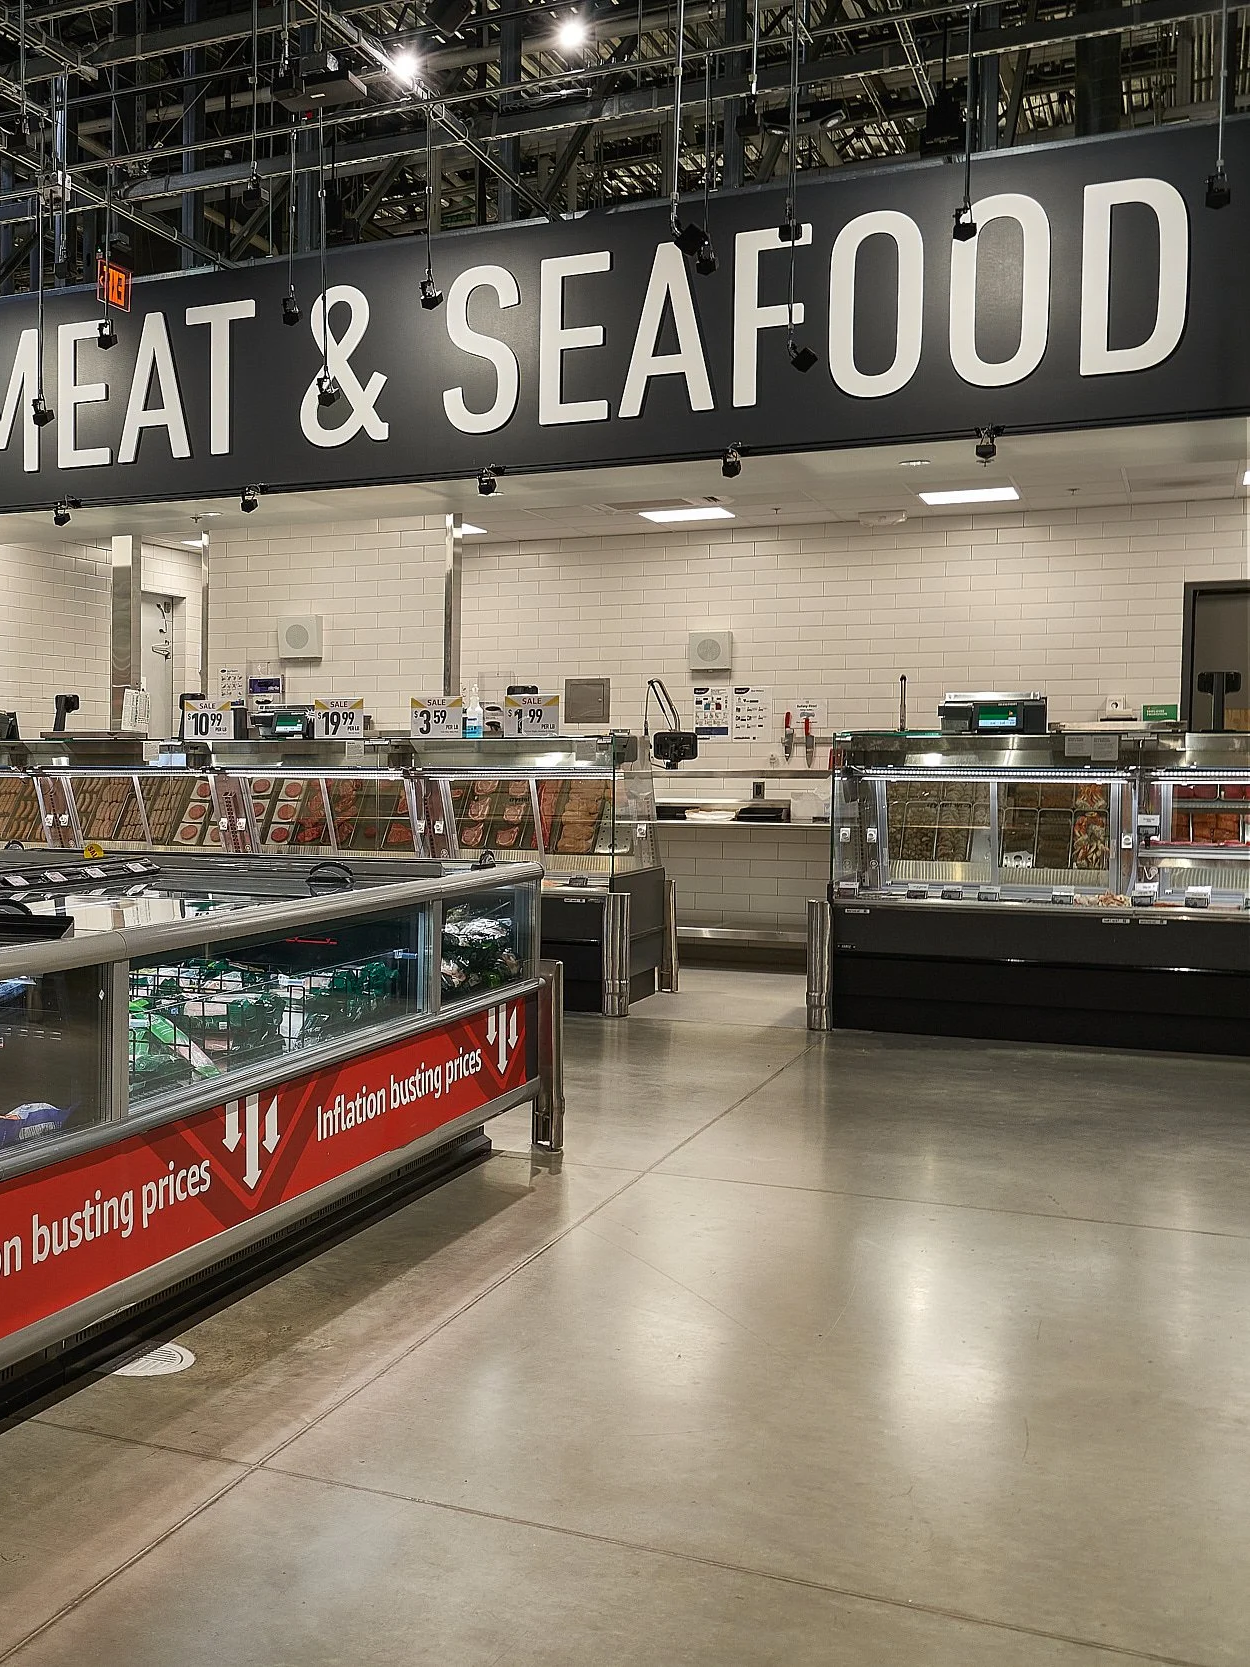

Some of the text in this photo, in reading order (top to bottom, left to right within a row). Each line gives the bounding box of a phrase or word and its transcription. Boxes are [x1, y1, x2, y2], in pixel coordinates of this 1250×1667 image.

[301, 286, 389, 449] &
[442, 177, 1192, 435] SEAFOOD
[316, 1045, 482, 1142] Inflation busting prices
[32, 1189, 134, 1264] busting
[141, 1158, 210, 1230] prices
